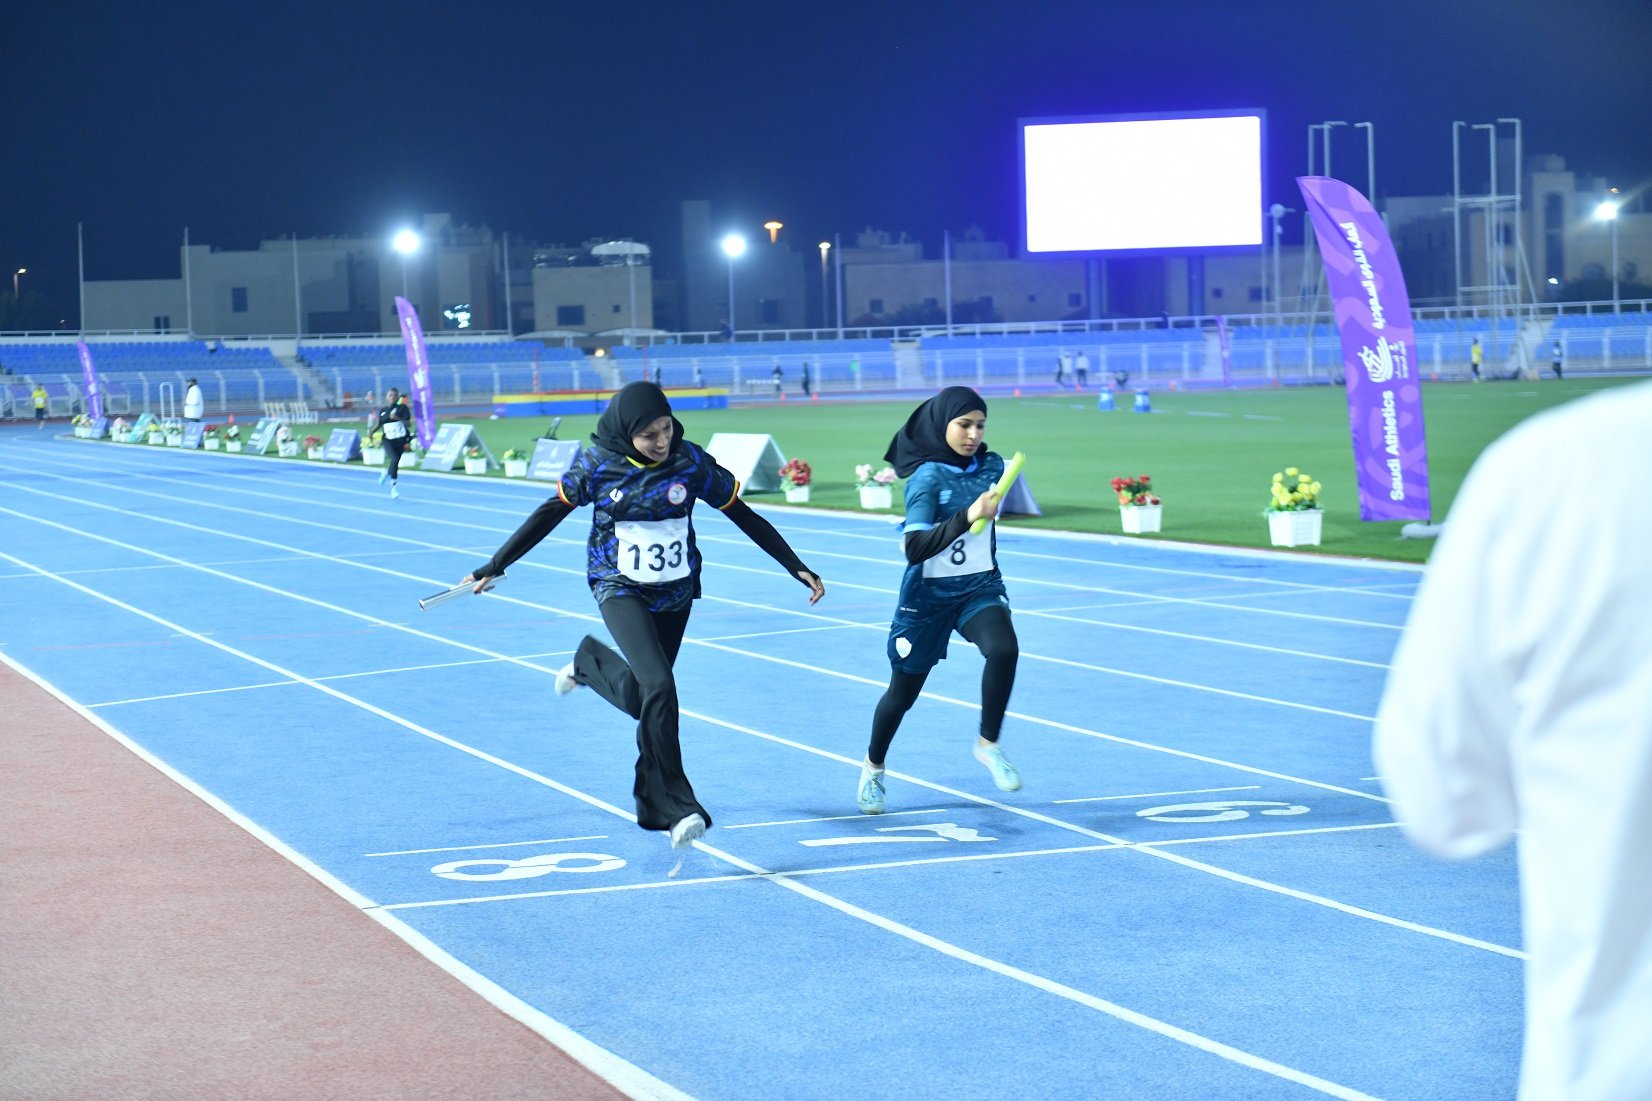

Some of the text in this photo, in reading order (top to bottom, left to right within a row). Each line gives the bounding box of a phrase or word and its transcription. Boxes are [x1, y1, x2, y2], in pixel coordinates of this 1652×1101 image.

[1361, 280, 1385, 329] السعودية
[1381, 391, 1401, 456] Athletics
[1387, 459, 1405, 500] Saudi
[627, 540, 683, 572] 133
[950, 538, 967, 565] 8
[1135, 801, 1312, 823] 6
[798, 822, 998, 848] 7
[430, 852, 628, 882] 8
